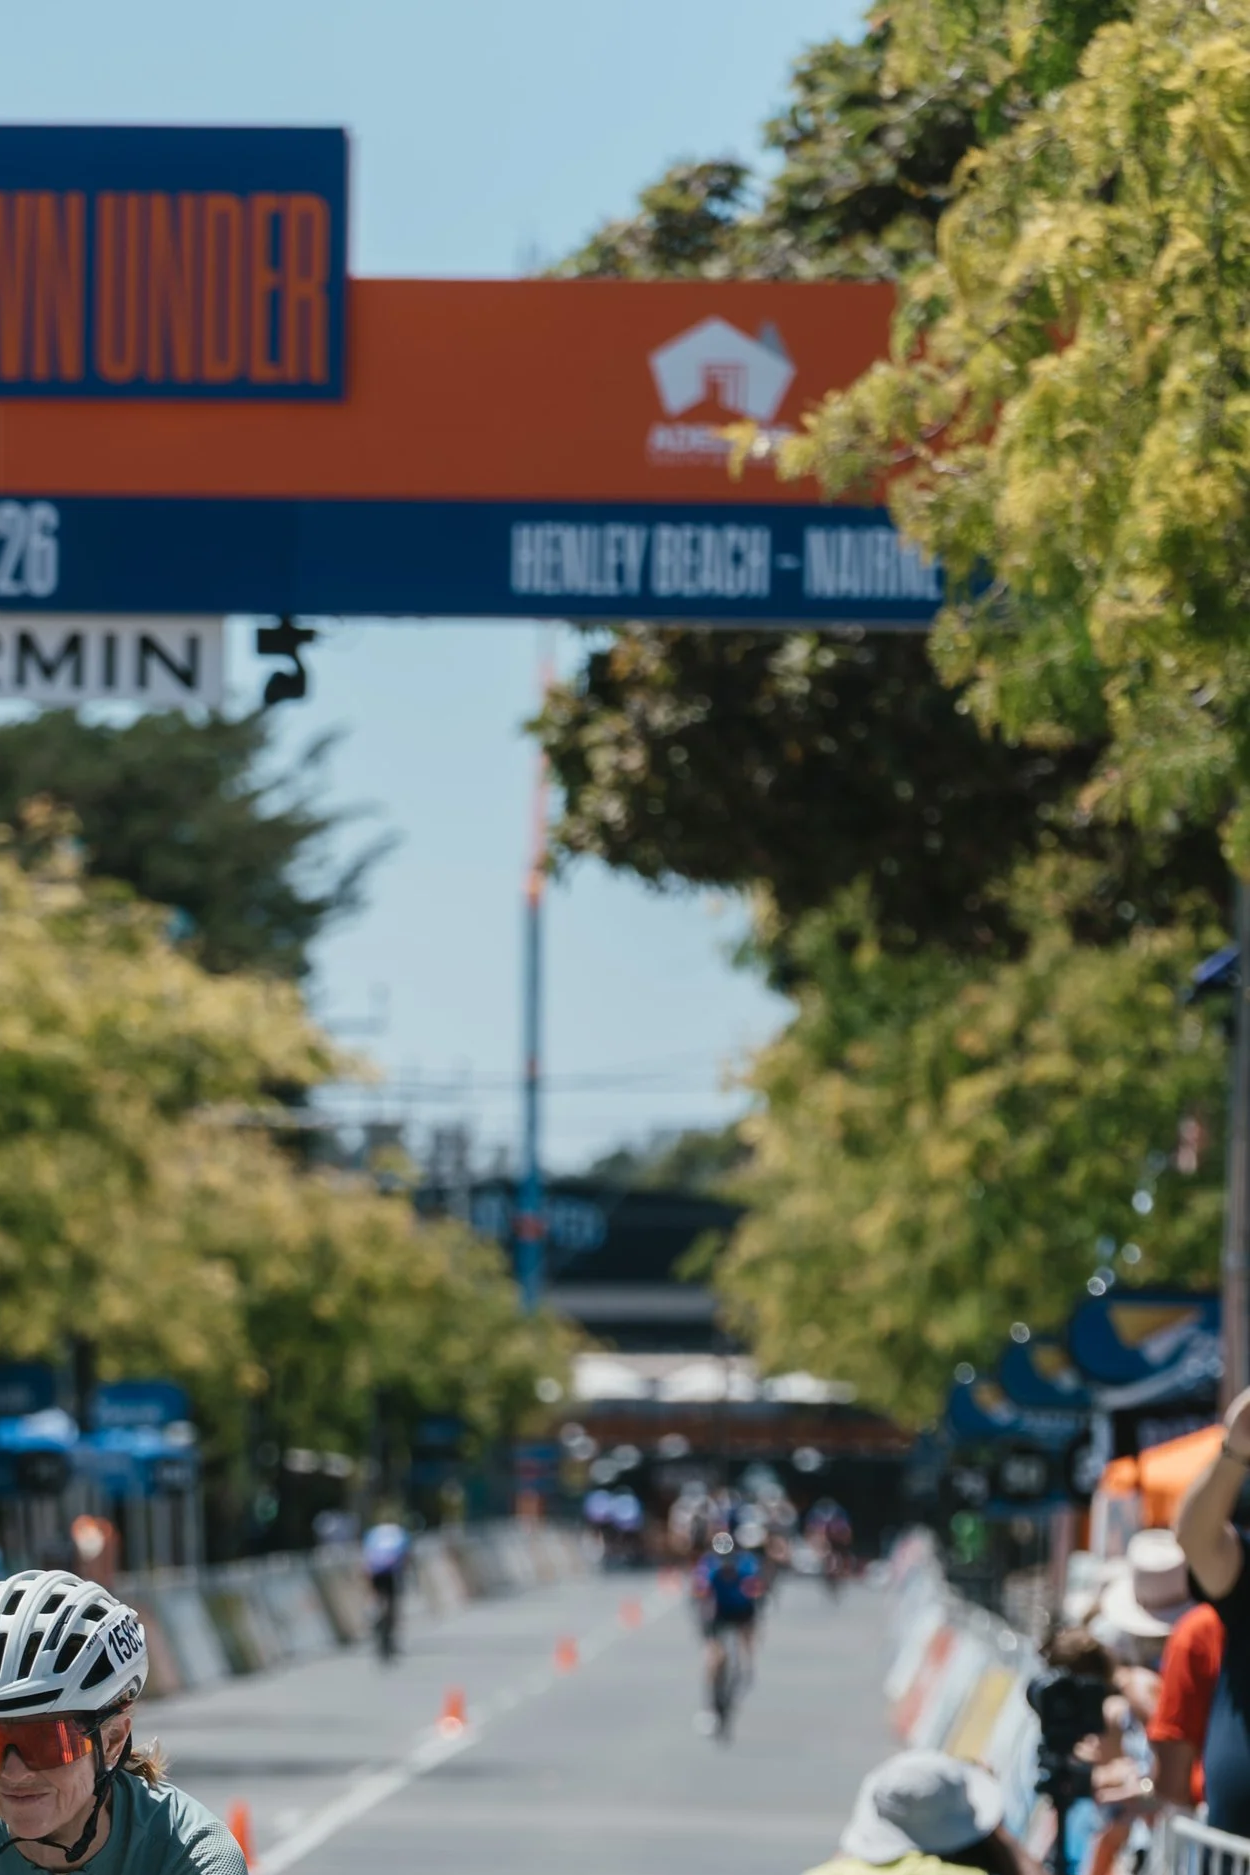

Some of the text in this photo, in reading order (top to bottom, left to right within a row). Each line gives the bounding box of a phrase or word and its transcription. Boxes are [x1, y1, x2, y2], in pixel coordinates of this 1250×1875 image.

[95, 191, 330, 384] UNDER
[511, 522, 647, 595] HENLEY
[652, 524, 771, 597] BEACH
[109, 1614, 143, 1664] 1585
